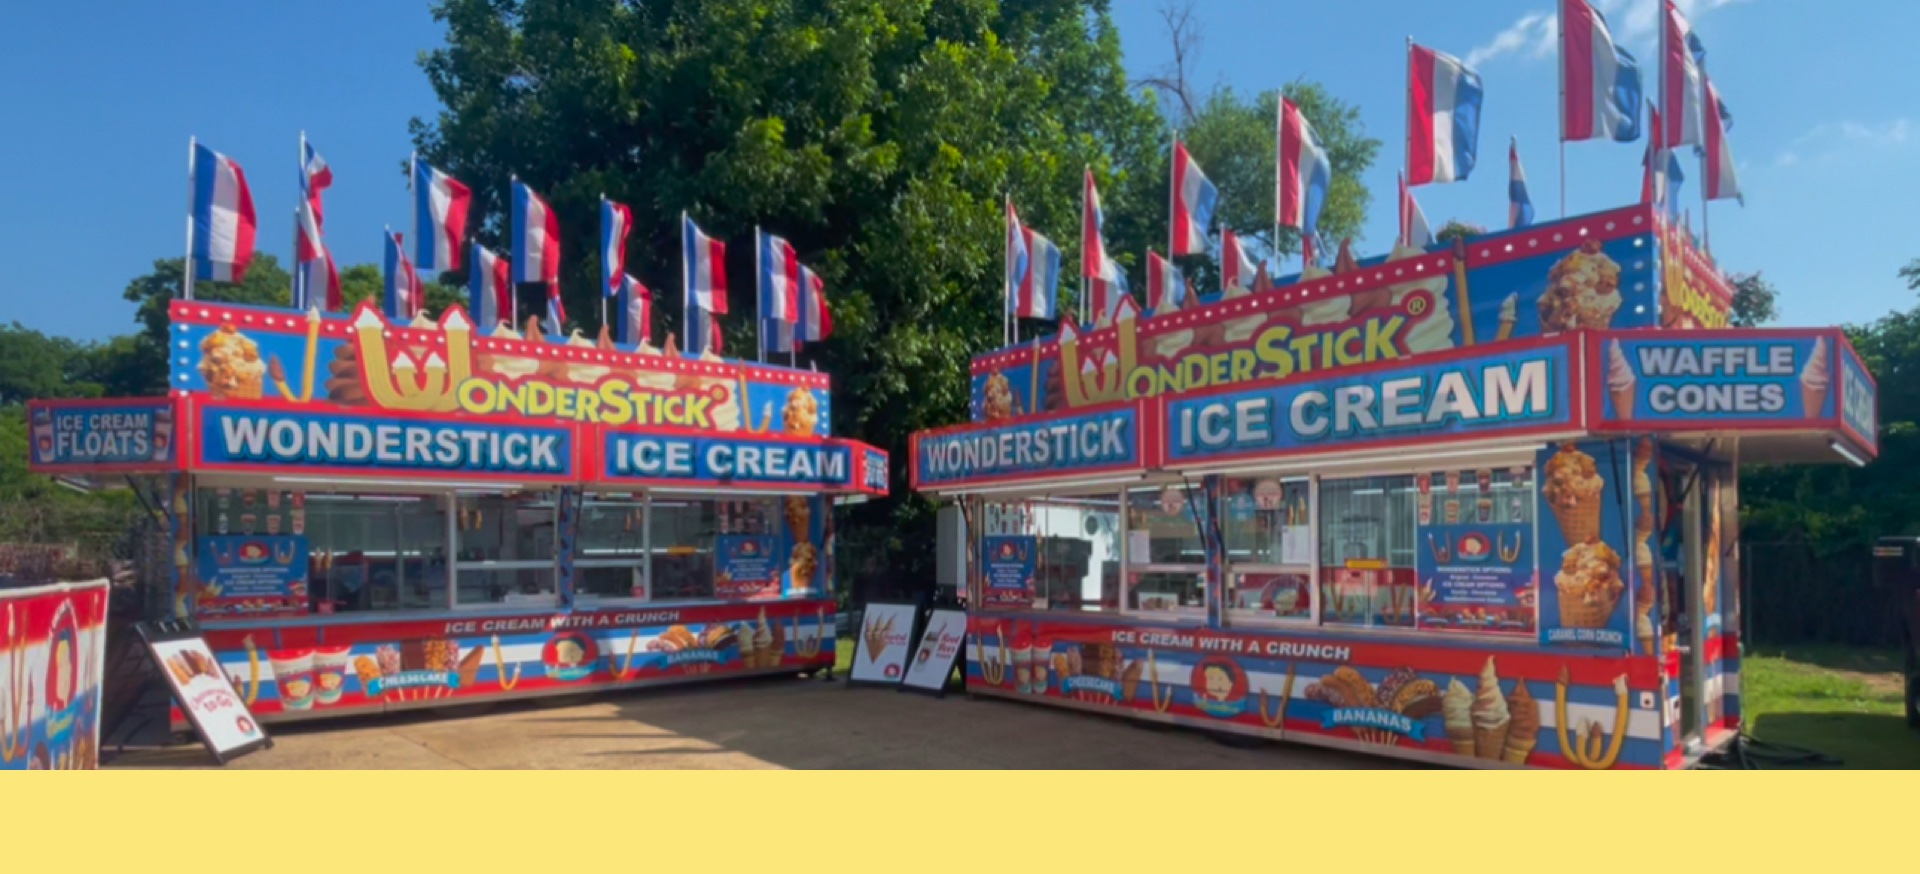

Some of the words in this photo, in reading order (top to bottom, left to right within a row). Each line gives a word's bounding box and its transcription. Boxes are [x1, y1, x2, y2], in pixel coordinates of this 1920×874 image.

[1639, 347, 1794, 375] WAFFLE
[1180, 399, 1268, 447] ICE
[1290, 360, 1550, 435] CREAM
[1650, 384, 1785, 412] CONES
[57, 414, 83, 431] ICE
[89, 413, 148, 430] CREAM
[57, 430, 148, 456] FLOATS
[221, 415, 558, 467] WONDERSTICK
[926, 417, 1125, 473] WONDERSTICK
[616, 439, 691, 472] ICE
[706, 444, 845, 479] CREAM
[446, 622, 475, 633] ICE
[481, 618, 545, 631] CREAM
[550, 615, 594, 628] WITH
[598, 615, 609, 625] A
[613, 611, 680, 623] CRUNCH
[1111, 631, 1134, 643] ICE
[1139, 633, 1194, 648] CREAM
[1199, 636, 1243, 651] WITH
[1248, 639, 1260, 653] A
[1266, 641, 1350, 660] CRUNCH
[1333, 709, 1412, 732] BANANAS
